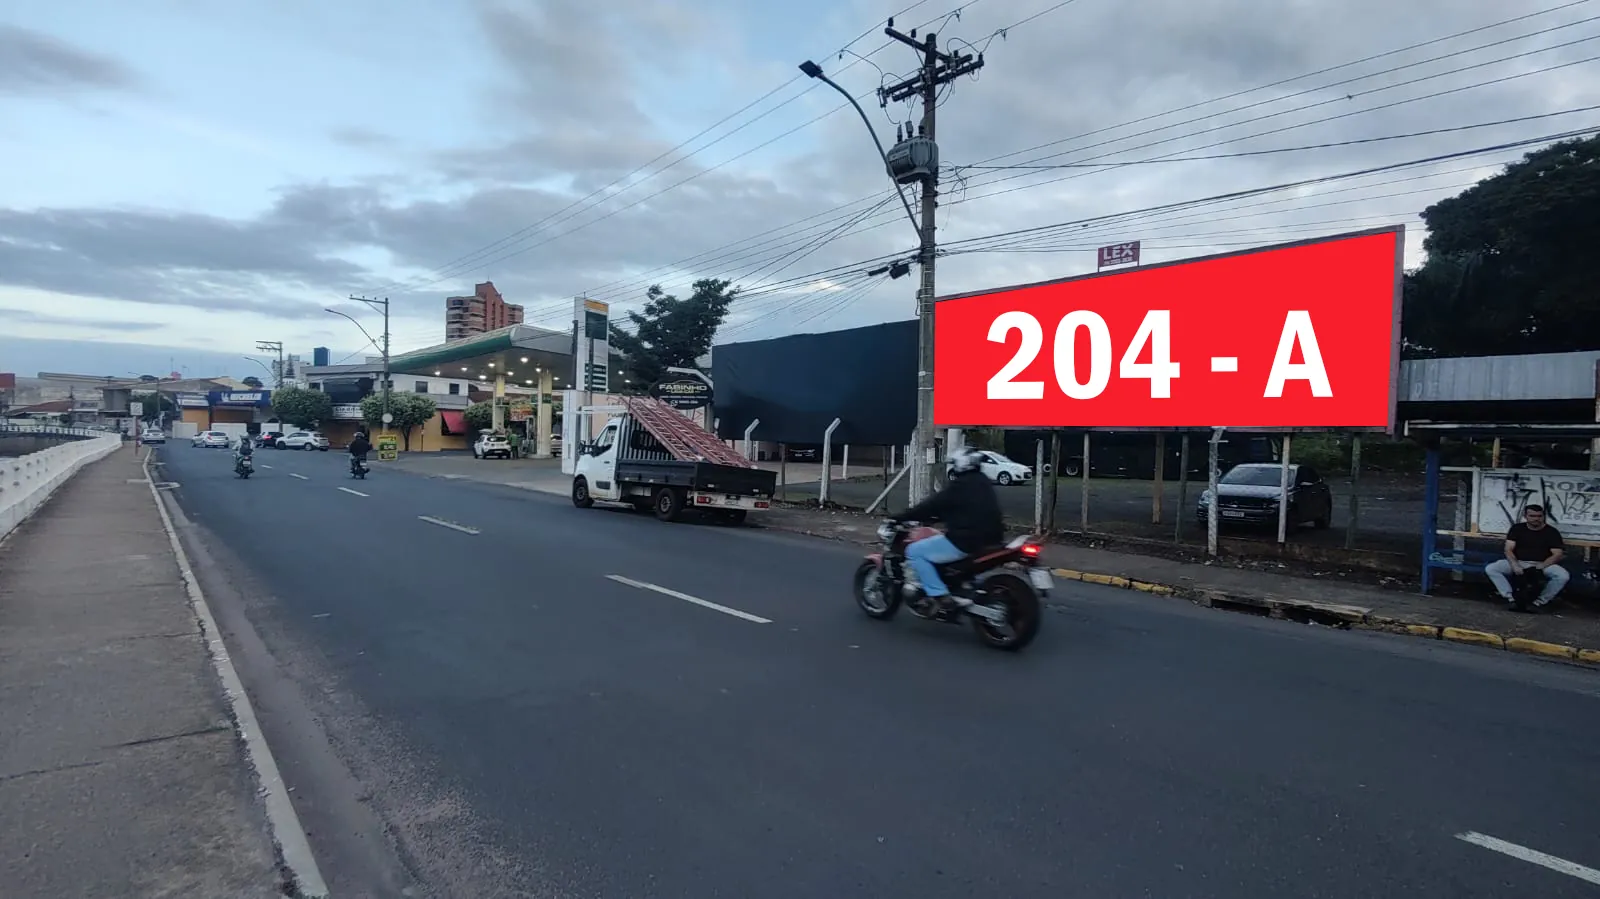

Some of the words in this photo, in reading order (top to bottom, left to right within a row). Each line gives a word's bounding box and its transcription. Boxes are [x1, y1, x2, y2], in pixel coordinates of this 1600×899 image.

[1103, 243, 1133, 260] LEX
[987, 310, 1180, 399] 204
[1211, 357, 1237, 371] -
[1264, 311, 1333, 397] A
